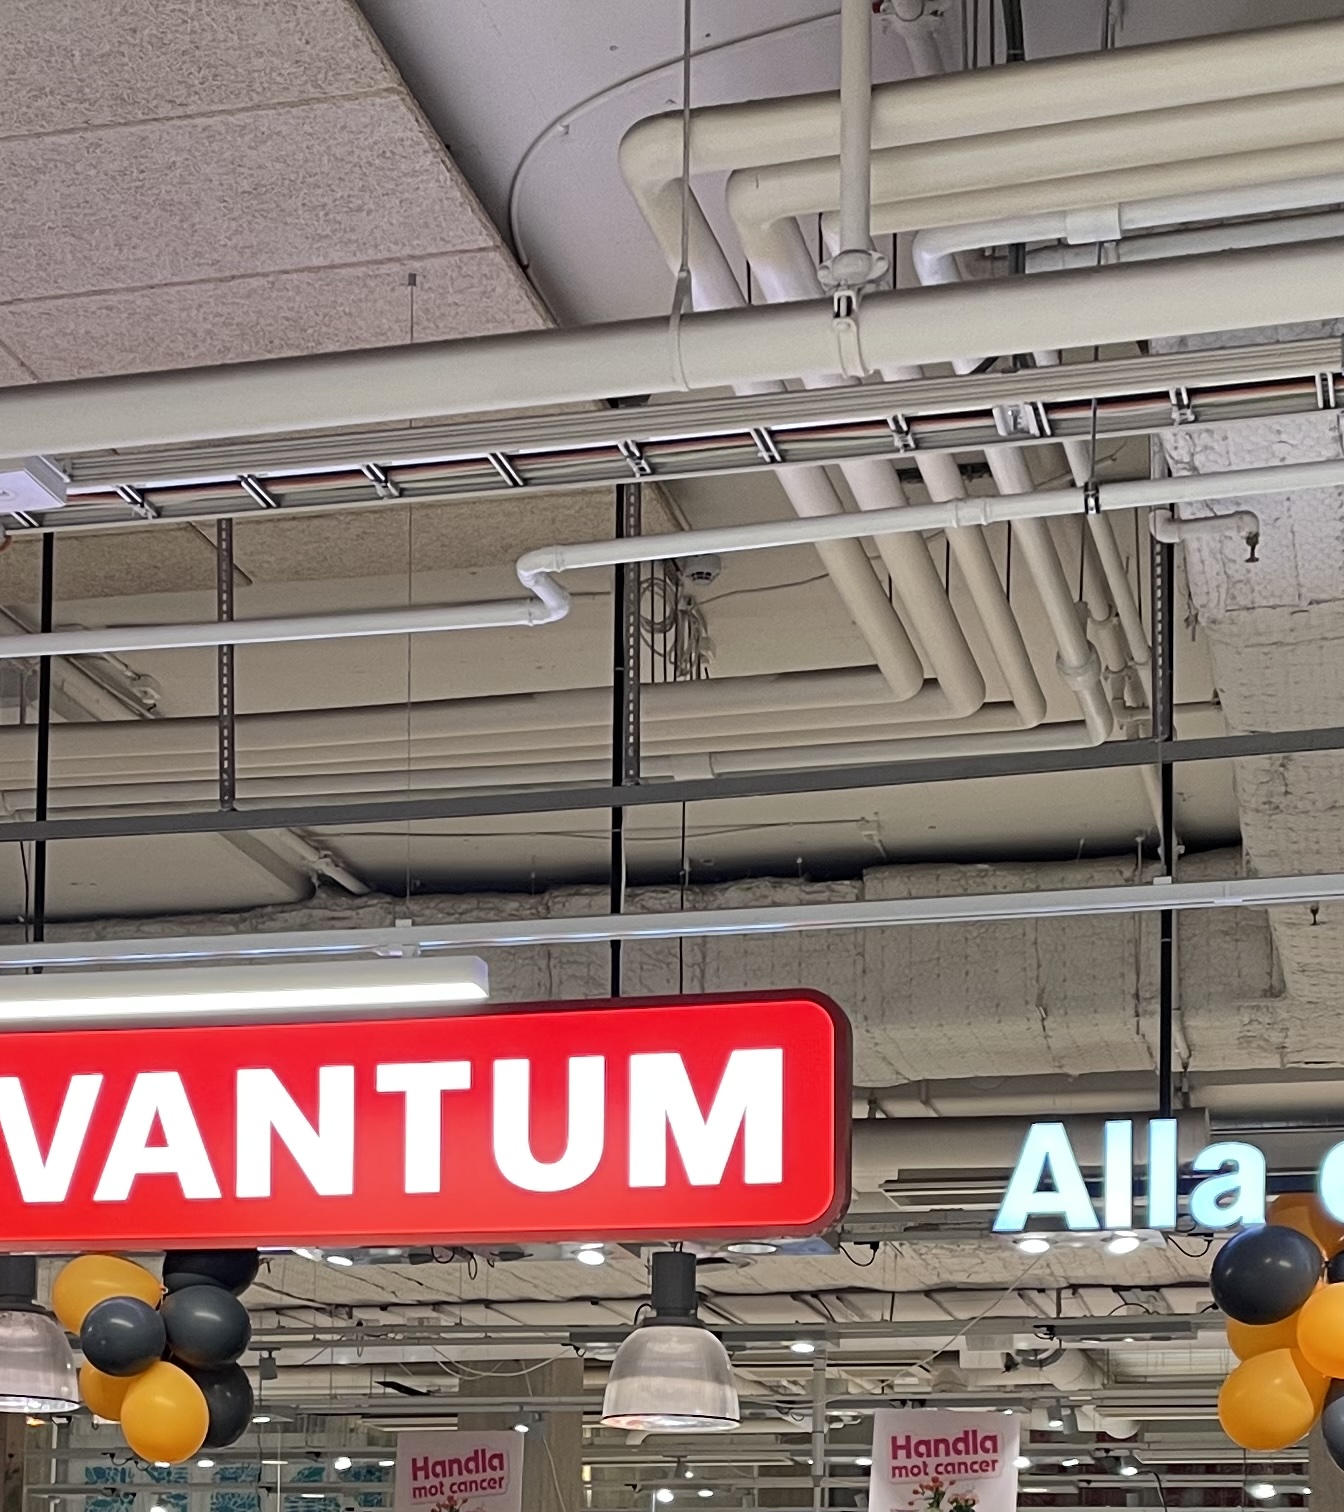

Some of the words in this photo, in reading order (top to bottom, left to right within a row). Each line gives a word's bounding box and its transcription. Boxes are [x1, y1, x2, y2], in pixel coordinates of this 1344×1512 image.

[992, 1118, 1268, 1233] Alla
[891, 1429, 998, 1460] Handla
[411, 1448, 504, 1481] Handla
[892, 1461, 929, 1478] mot
[935, 1459, 998, 1475] cancer
[413, 1480, 444, 1499] mot
[449, 1476, 504, 1495] cancer
